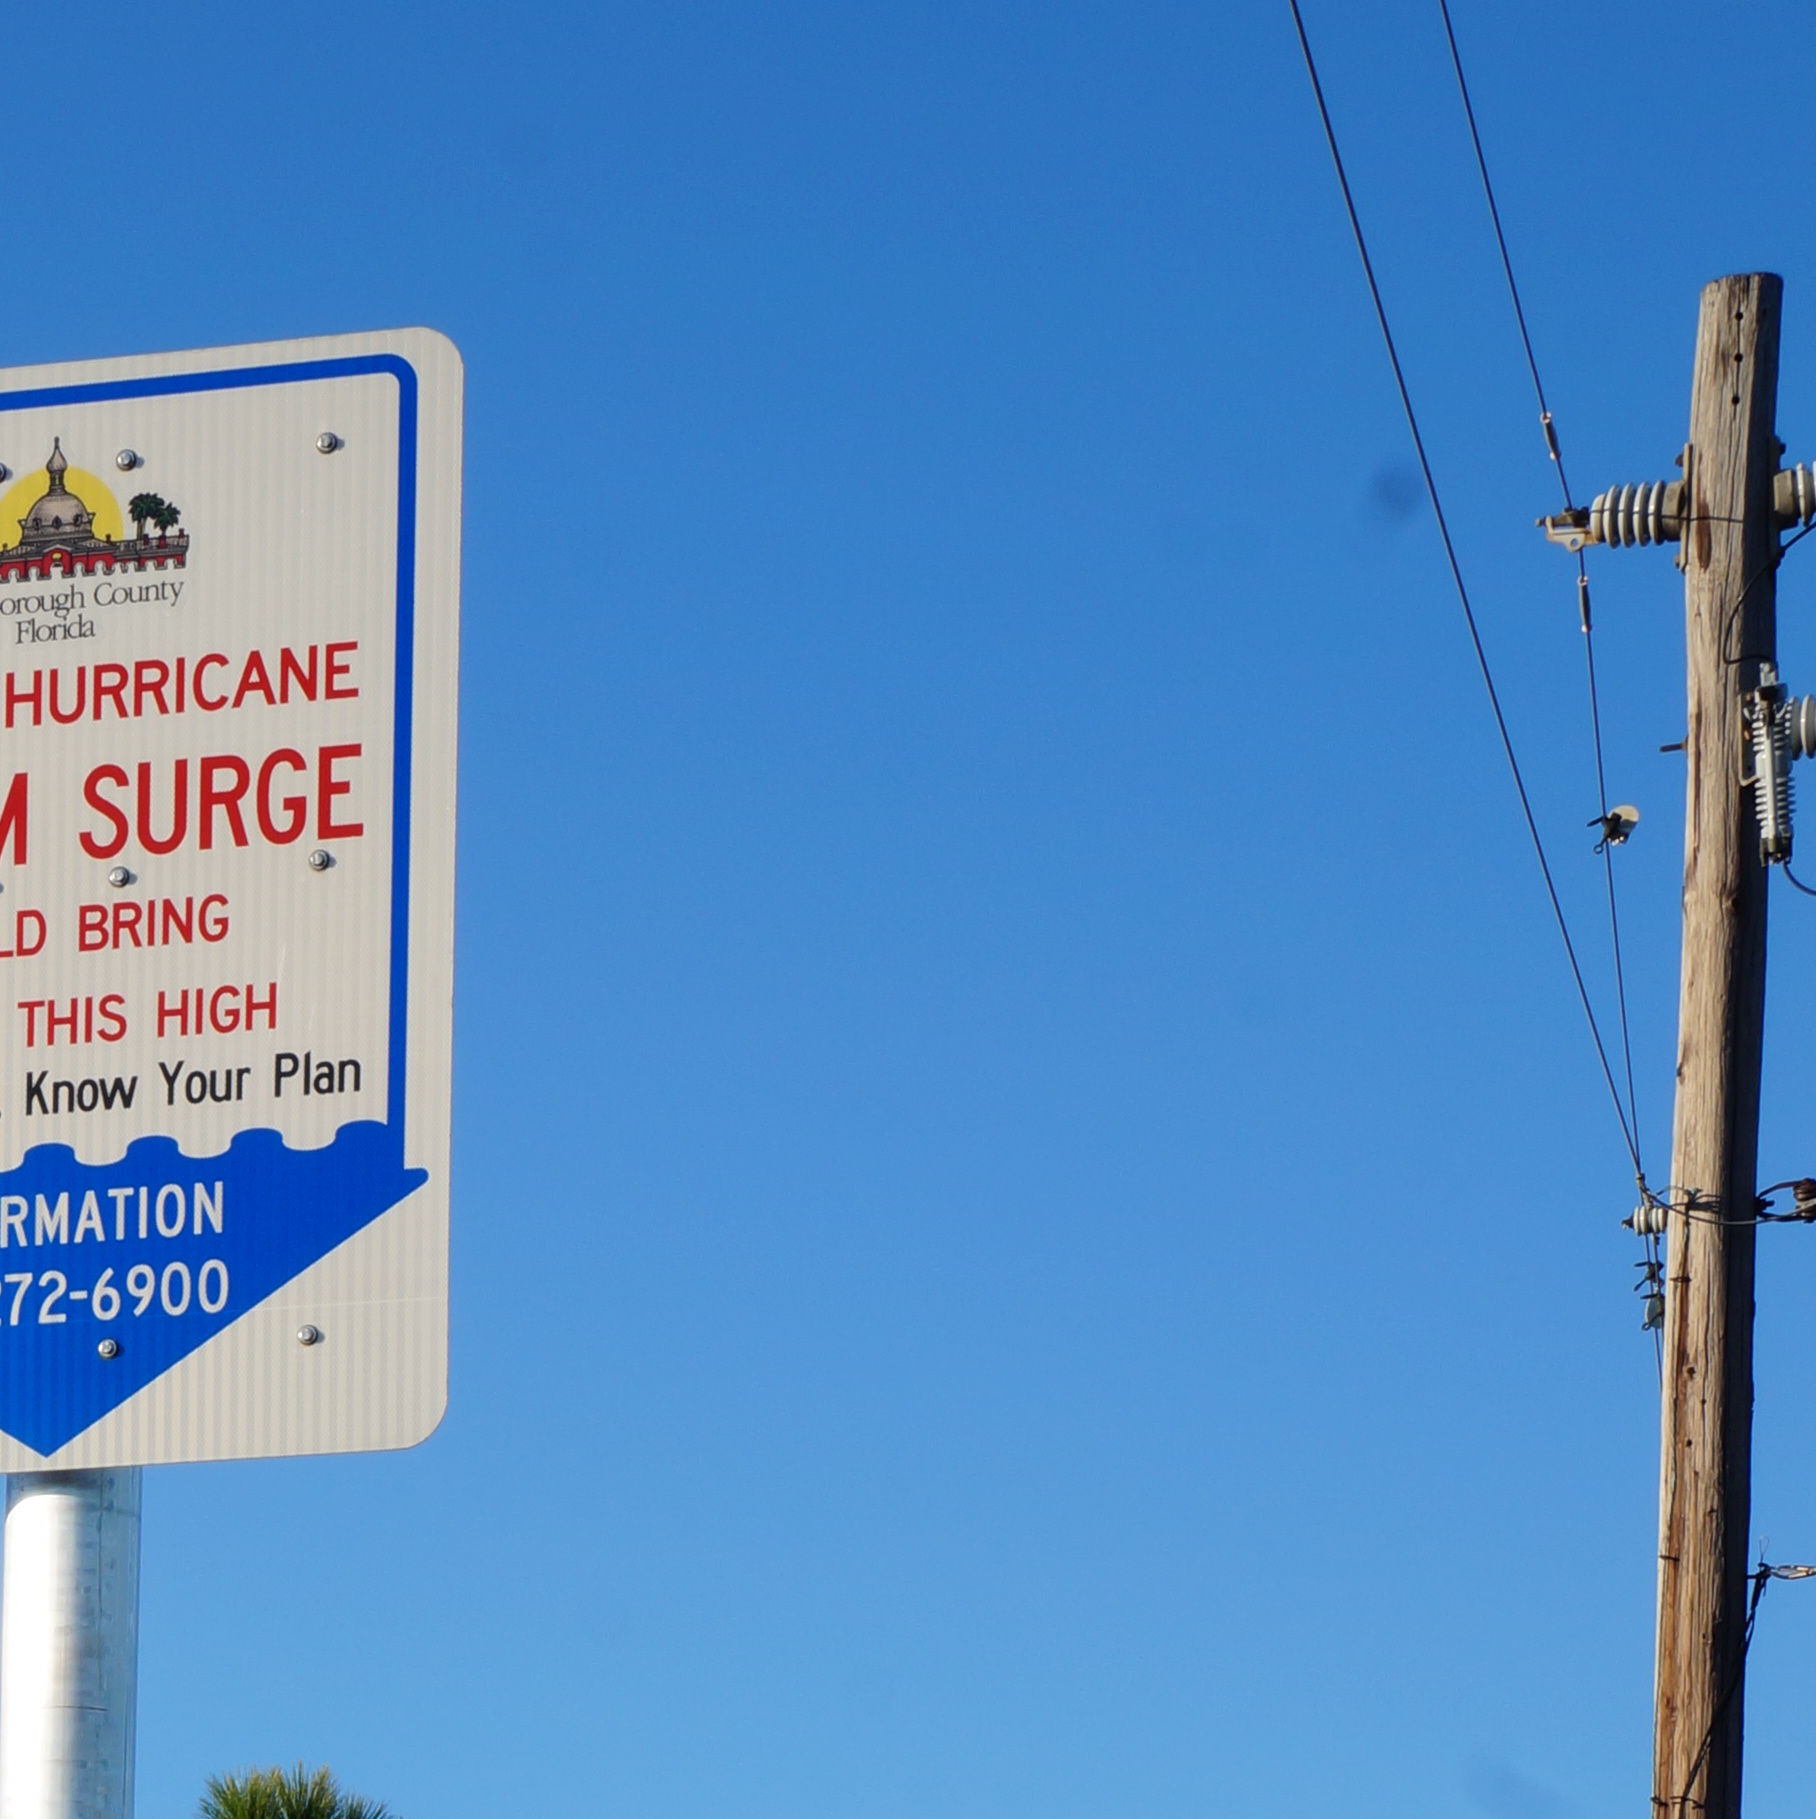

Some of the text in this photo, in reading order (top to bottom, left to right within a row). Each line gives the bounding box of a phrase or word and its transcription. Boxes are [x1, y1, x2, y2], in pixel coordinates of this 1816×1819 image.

[93, 580, 185, 607] County
[15, 613, 96, 645] Florida
[5, 641, 359, 728] HURRICANE
[79, 743, 364, 860] SURGE
[78, 893, 230, 952] BRING
[18, 994, 128, 1047] THIS
[157, 981, 278, 1038] HIGH
[25, 1070, 138, 1116] Know
[159, 1060, 251, 1106] Your
[274, 1051, 362, 1098] Plan
